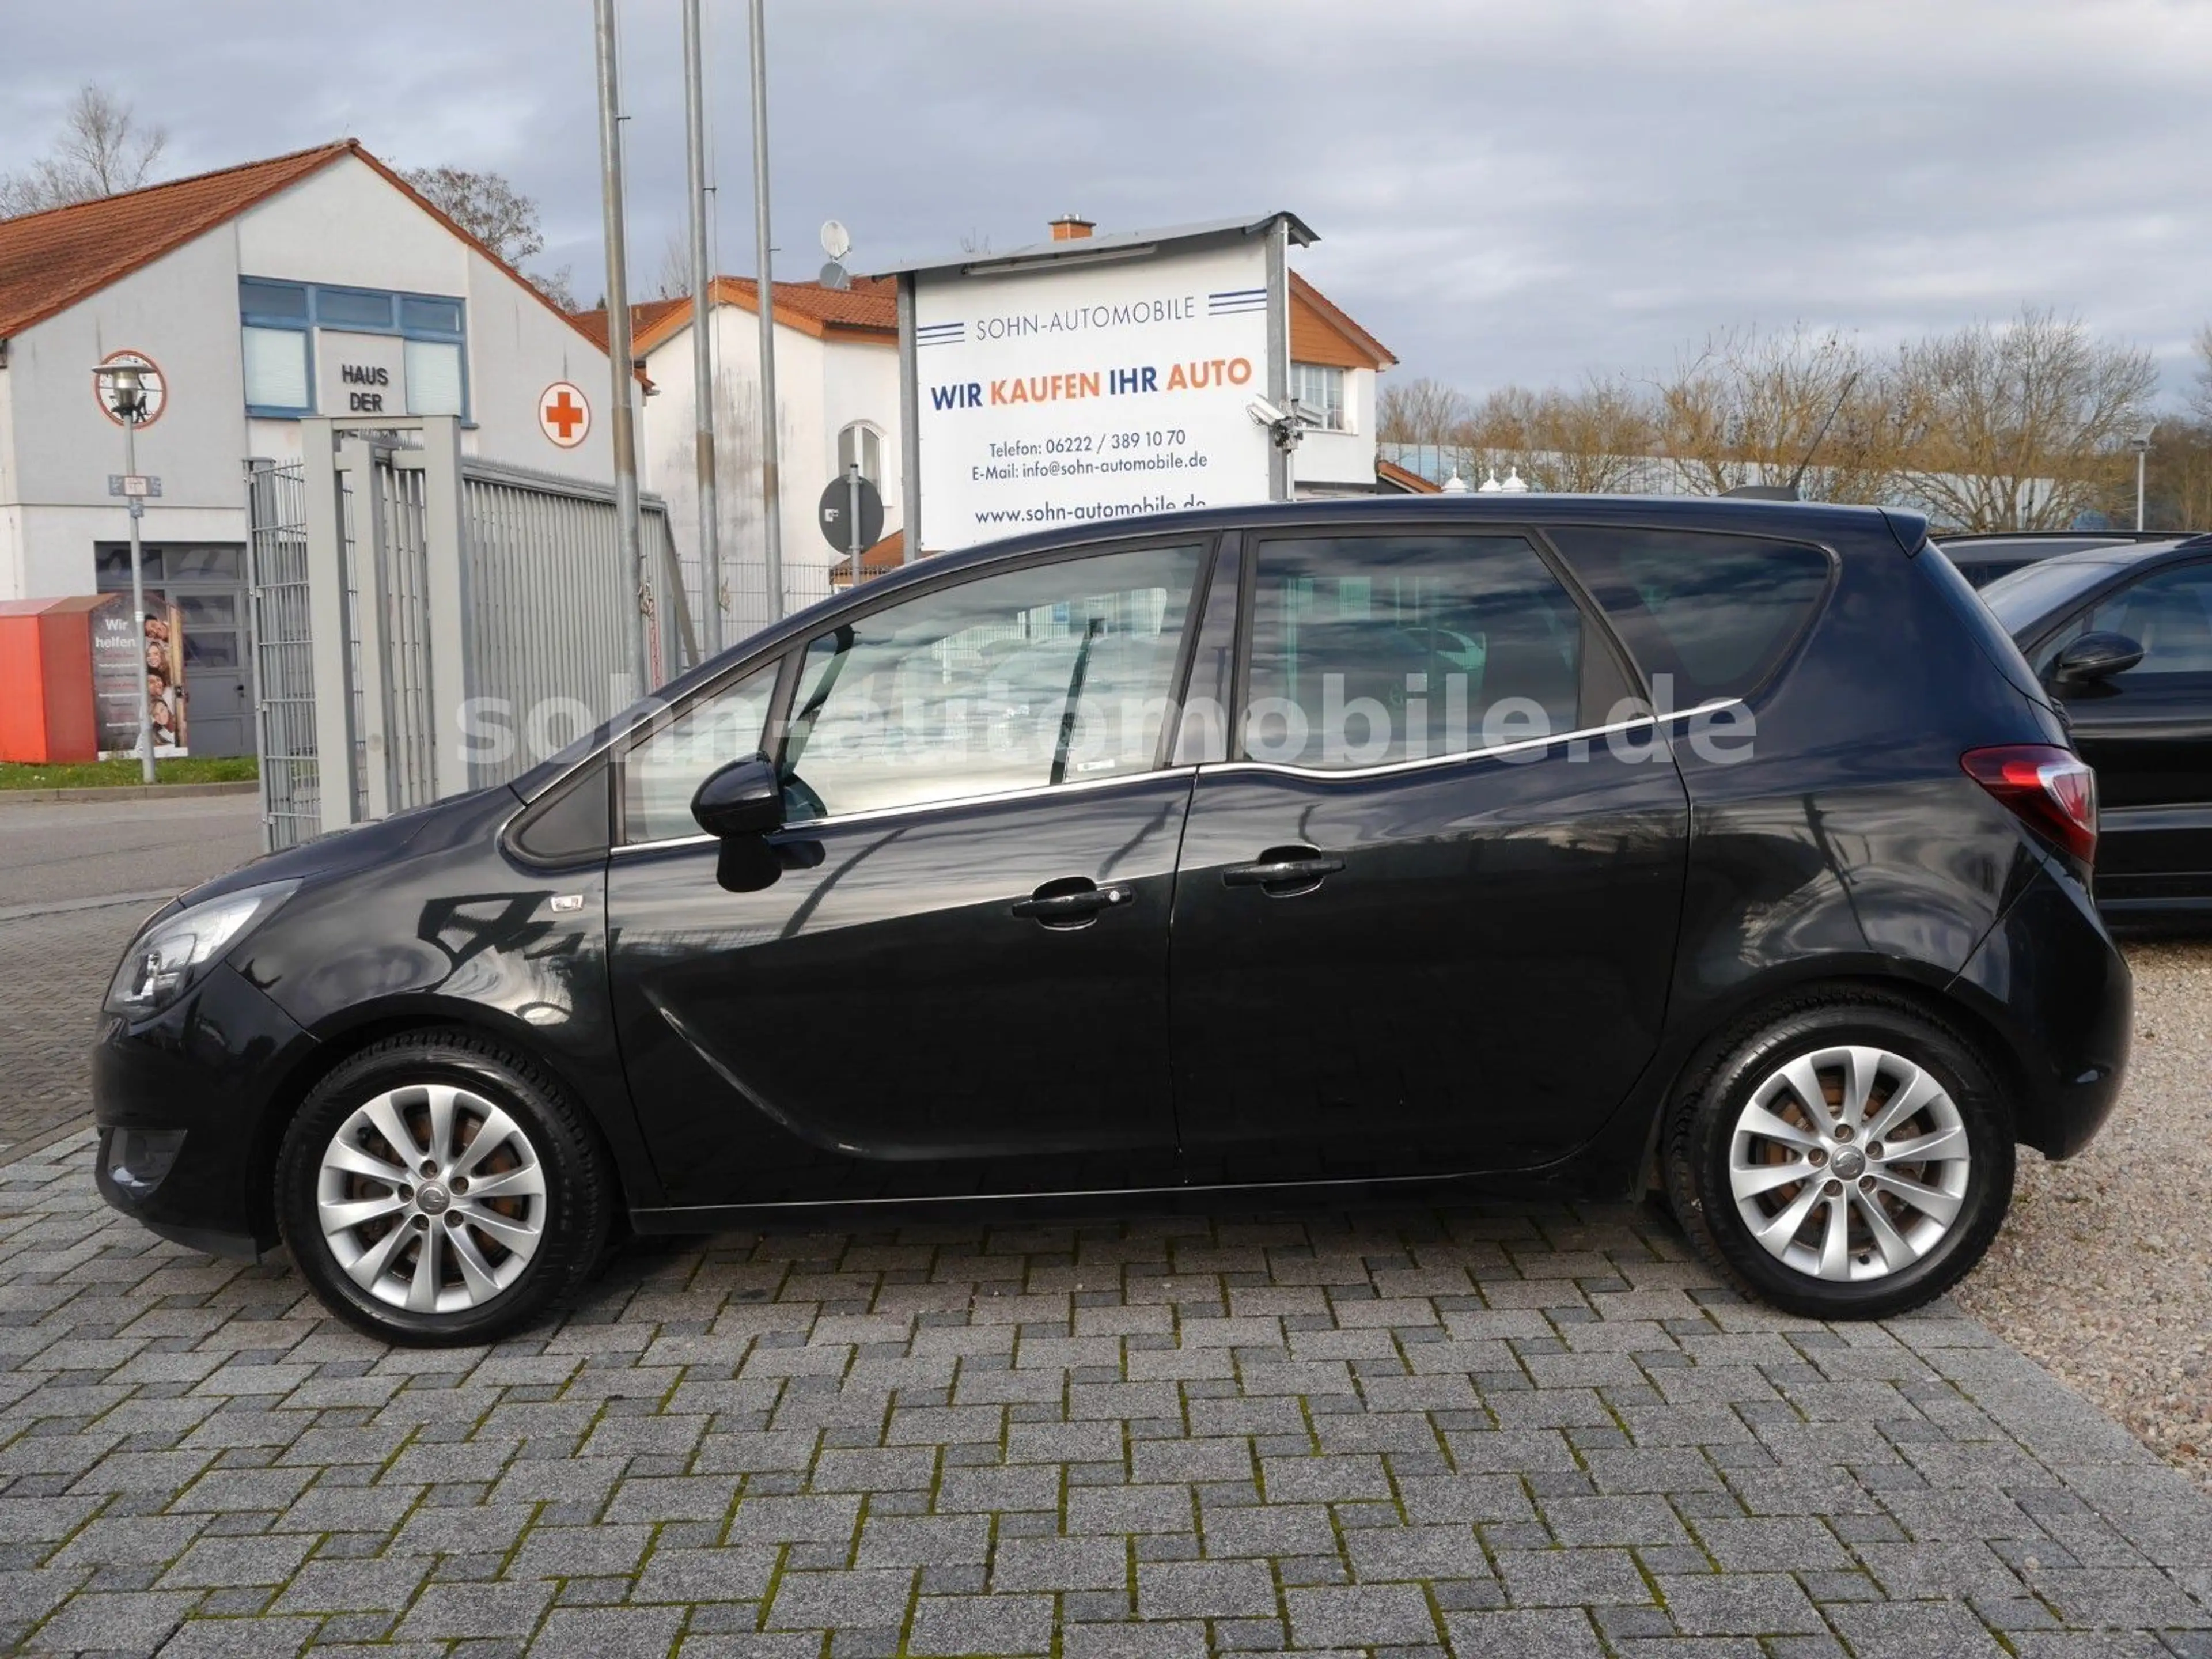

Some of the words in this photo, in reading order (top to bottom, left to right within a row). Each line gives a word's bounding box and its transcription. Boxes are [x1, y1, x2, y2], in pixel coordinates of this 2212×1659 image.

[976, 296, 1195, 340] SOHN-AUTOMOBILE
[342, 365, 389, 386] HAUS
[931, 382, 983, 410] WIR
[991, 372, 1100, 405] KAUFEN
[1109, 366, 1158, 395] IHR
[1166, 357, 1252, 391] AUTO
[350, 392, 383, 412] DER
[990, 440, 1042, 457] Telefon:
[1046, 437, 1092, 454] 06222
[1096, 434, 1106, 454] /
[1111, 432, 1139, 449] 389
[1146, 431, 1162, 446] 10
[1166, 429, 1185, 446] 70
[972, 464, 1018, 480] E-Mail:
[1022, 451, 1207, 478] info@sohn-automobile.de
[105, 619, 128, 630] Wir
[96, 637, 136, 649] helfen
